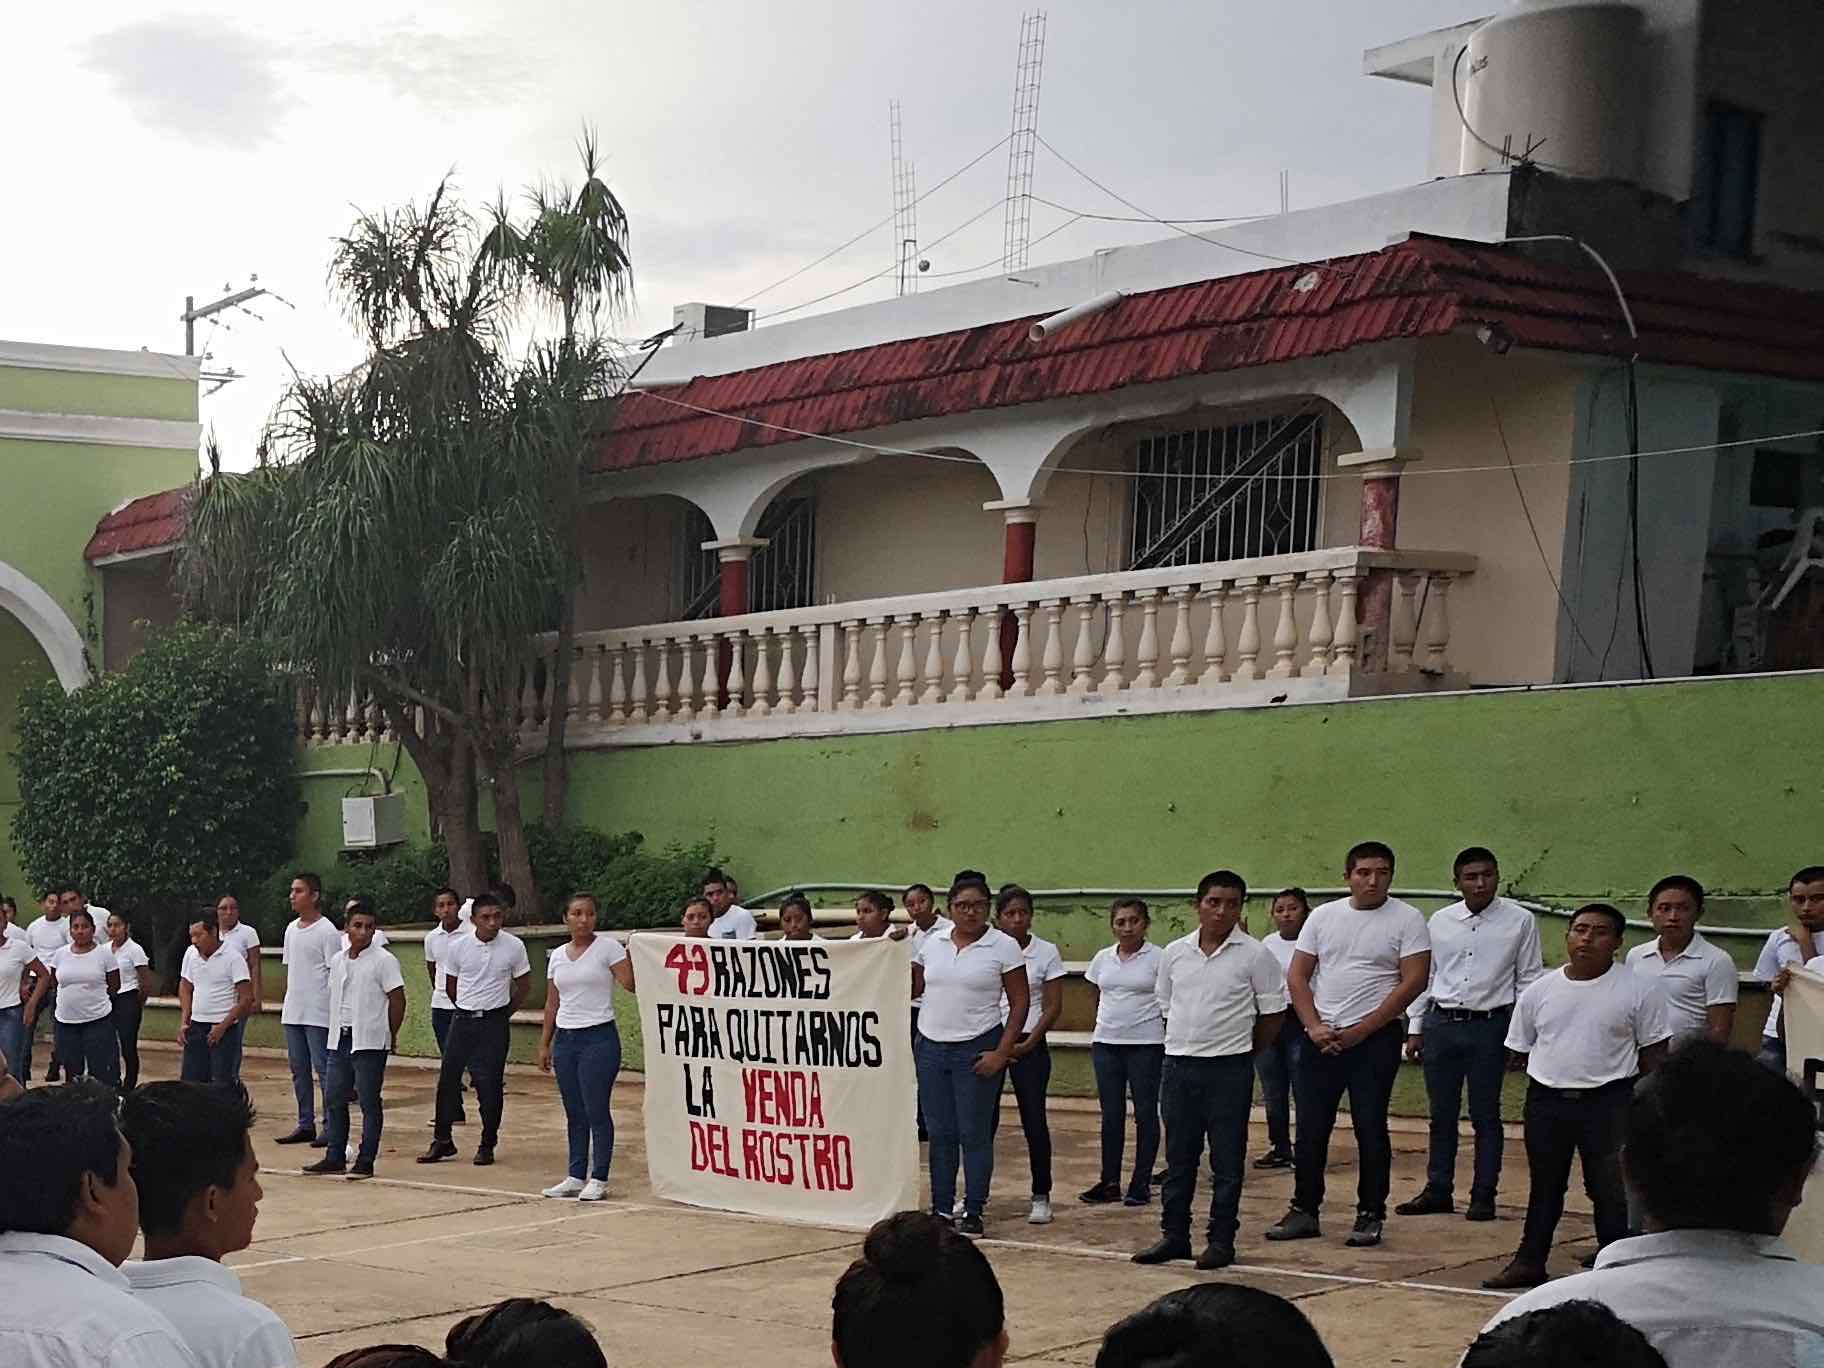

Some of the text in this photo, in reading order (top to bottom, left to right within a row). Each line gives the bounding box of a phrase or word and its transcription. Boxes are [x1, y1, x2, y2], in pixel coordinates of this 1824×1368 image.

[709, 945, 831, 1000] RAZONES
[656, 1003, 883, 1069] PARA QUITARNOS
[683, 1063, 824, 1129] LA VENDA
[689, 1120, 854, 1191] DEL ROSTRO
